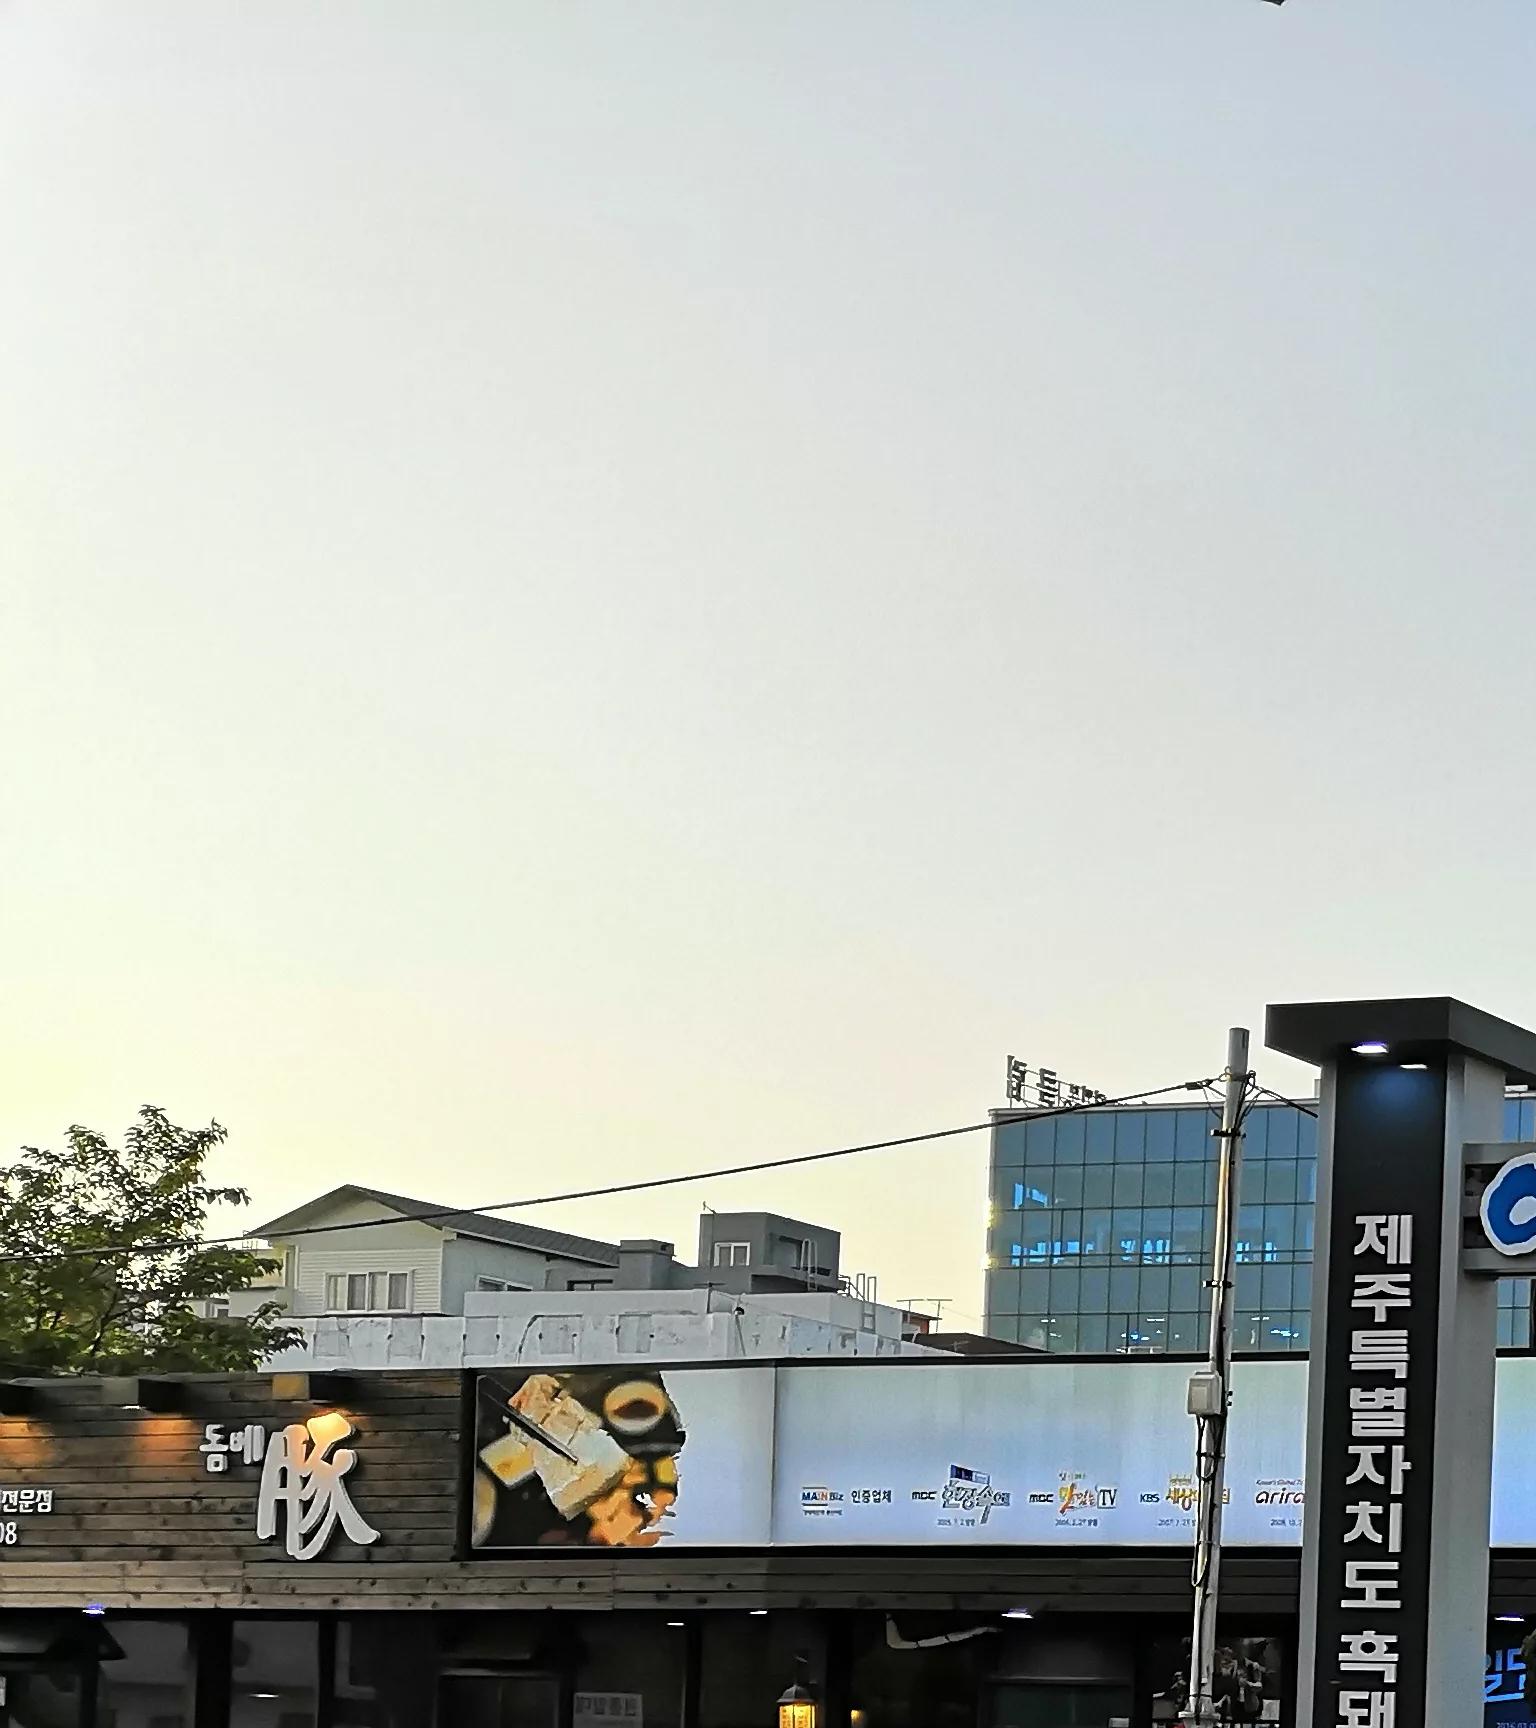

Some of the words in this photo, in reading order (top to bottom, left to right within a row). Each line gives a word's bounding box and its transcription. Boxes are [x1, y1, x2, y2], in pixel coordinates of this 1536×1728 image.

[1340, 1213, 1413, 1610] 제주특별자치도
[199, 1424, 265, 1472] 돔베
[851, 1489, 892, 1504] 인증업체
[1099, 1488, 1117, 1507] TV
[1139, 1493, 1160, 1503] KBS
